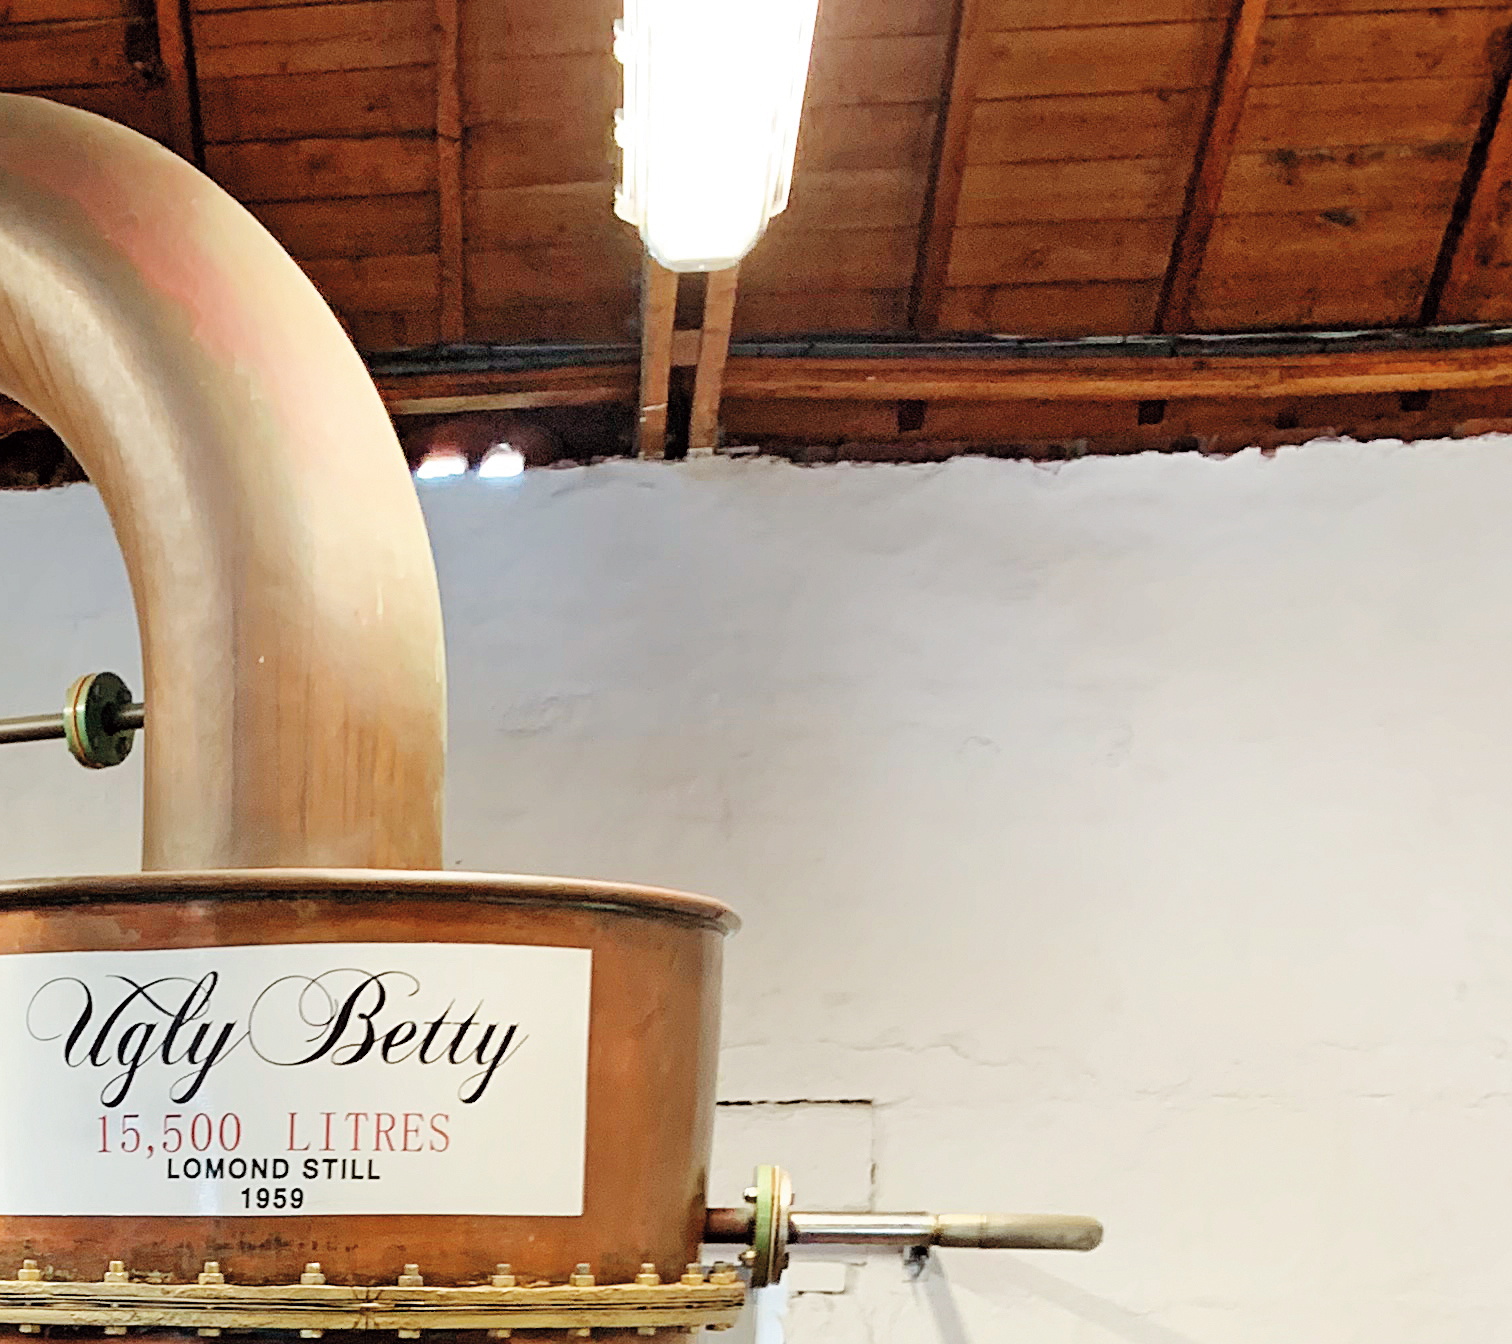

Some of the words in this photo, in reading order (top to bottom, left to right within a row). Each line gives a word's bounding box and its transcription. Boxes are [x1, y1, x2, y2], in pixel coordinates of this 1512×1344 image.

[26, 970, 250, 1108] Ugly
[249, 967, 530, 1105] Betty
[95, 1113, 242, 1159] 15,500
[286, 1112, 451, 1153] LITRES
[167, 1158, 290, 1181] LOMOND
[302, 1158, 381, 1181] STILL
[240, 1188, 305, 1210] 1959
